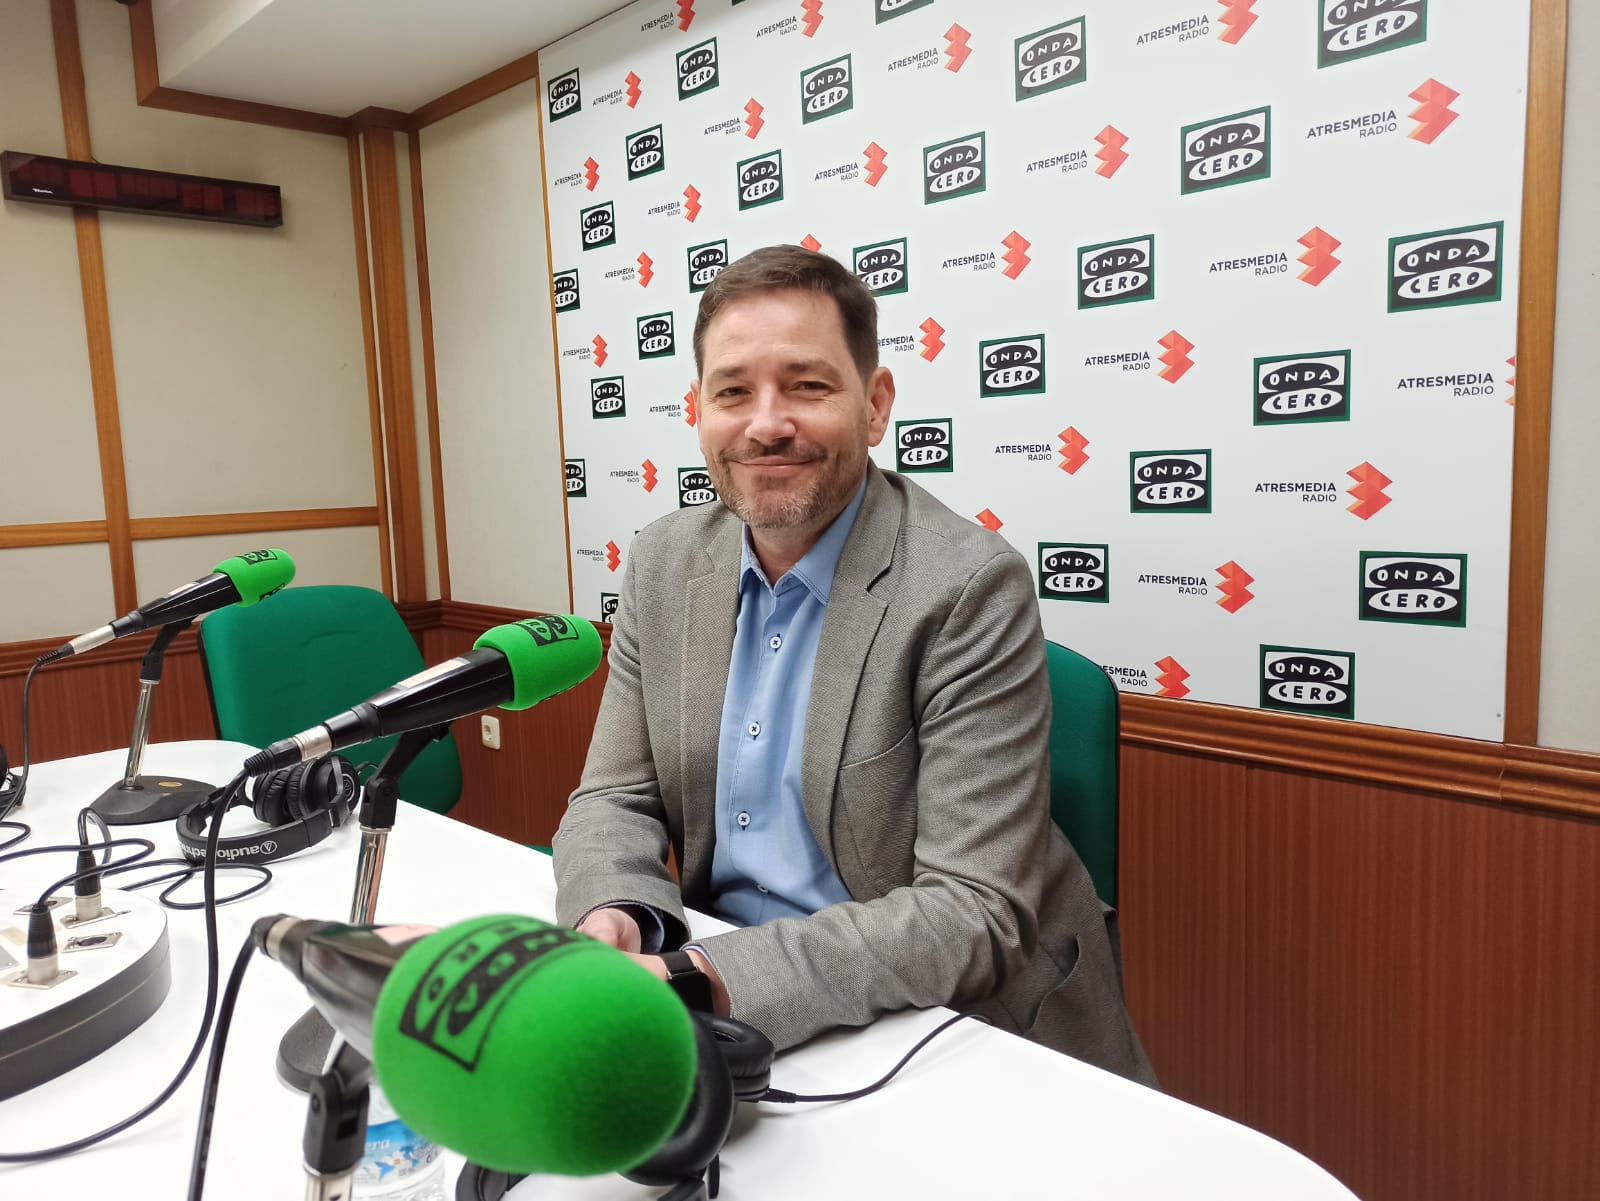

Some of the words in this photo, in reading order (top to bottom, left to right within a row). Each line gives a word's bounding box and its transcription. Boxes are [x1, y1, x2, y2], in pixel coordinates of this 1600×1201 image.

[1336, 0, 1395, 19] ON
[640, 12, 674, 32] ATRESMEDIA
[660, 19, 674, 30] RADIO
[756, 16, 797, 38] ATRESMEDIA
[779, 24, 798, 36] RADIO
[1136, 15, 1209, 46] ATRESMEDIA
[1178, 26, 1209, 43] RADIO
[1339, 15, 1406, 46] CERO
[1026, 37, 1072, 62] ONDA
[683, 52, 710, 71] ONDA
[887, 47, 938, 72] ATRESMEDIA
[917, 57, 939, 70] RADIO
[685, 69, 711, 86] CERO
[1029, 59, 1073, 83] CERO
[809, 70, 843, 91] ONDA
[553, 80, 575, 96] ONDA
[554, 95, 575, 111] CERO
[592, 89, 623, 107] ATRESMEDIA
[610, 95, 623, 106] RADIO
[811, 90, 843, 109] CERO
[704, 117, 740, 136] ATRESMEDIA
[725, 125, 741, 135] RADIO
[1307, 110, 1397, 139] ATRESMEDIA
[1359, 122, 1397, 138] RADIO
[632, 137, 657, 153] ONDA
[1195, 128, 1253, 151] ONDA
[634, 153, 658, 169] CERO
[933, 150, 974, 169] ONDA
[1026, 150, 1087, 173] ATRESMEDIA
[1061, 160, 1088, 173] RADIO
[1198, 152, 1253, 176] CERO
[744, 164, 774, 180] ONDA
[814, 162, 858, 181] ATRESMEDIA
[840, 171, 859, 182] RADIO
[554, 172, 582, 186] ATRESMEDIA
[570, 178, 582, 187] RADIO
[936, 169, 974, 189] CERO
[746, 181, 775, 198] CERO
[647, 201, 681, 216] ATRESMEDIA
[667, 208, 681, 217] RADIO
[586, 213, 609, 226] ONDA
[588, 227, 609, 241] CERO
[694, 253, 721, 265] ONDA
[862, 253, 897, 269] ONDA
[942, 252, 996, 269] ATRESMEDIA
[1089, 253, 1139, 272] ONDA
[1209, 252, 1288, 273] ATRESMEDIA
[1407, 245, 1480, 267] ONDA
[604, 267, 635, 279] ATRESMEDIA
[973, 261, 996, 272] RADIO
[1254, 264, 1288, 277] RADIO
[1092, 275, 1140, 293] CERO
[1410, 271, 1480, 293] CERO
[643, 323, 667, 334] ONDA
[645, 338, 668, 349] CERO
[877, 335, 914, 347] RESMEDIA
[894, 343, 914, 352] RADIO
[563, 347, 590, 357] ATRESMEDIA
[989, 350, 1032, 364] ONDA
[1084, 351, 1150, 367] ATRESMEDIA
[1122, 362, 1150, 372] RADIO
[992, 370, 1033, 385] CERO
[1269, 369, 1331, 386] ONDA
[1397, 373, 1494, 389] ATRESMEDIA
[596, 386, 619, 396] ONDA
[1453, 385, 1495, 397] RADIO
[598, 400, 620, 410] CERO
[649, 404, 681, 413] ATRESMEDIA
[1272, 393, 1332, 410] CERO
[904, 432, 942, 443] ONDA
[994, 443, 1052, 454] ATRESMEDIA
[907, 450, 942, 462] CERO
[1027, 453, 1052, 462] RADIO
[610, 470, 639, 478] ATRESMEDIA
[1143, 465, 1196, 478] ONDA
[567, 481, 581, 489] ERO
[684, 478, 710, 486] ONDA
[1255, 482, 1337, 493] ATRESMEDIA
[686, 492, 710, 501] CERO
[1146, 486, 1196, 500] CERO
[1302, 494, 1337, 502] RADIO
[577, 549, 604, 557] ATRESMEDIA
[1049, 557, 1095, 568] ONDA
[1052, 576, 1095, 588] CERO
[1138, 574, 1207, 586] ATRESMEDIA
[1376, 569, 1446, 582] ONDA
[1178, 586, 1208, 595] RADIO
[1380, 594, 1445, 609] CERO
[1102, 665, 1147, 679] ESMEDIA
[1275, 662, 1337, 678] ONDA
[1121, 677, 1148, 687] RADIO
[1278, 685, 1337, 702] CERO
